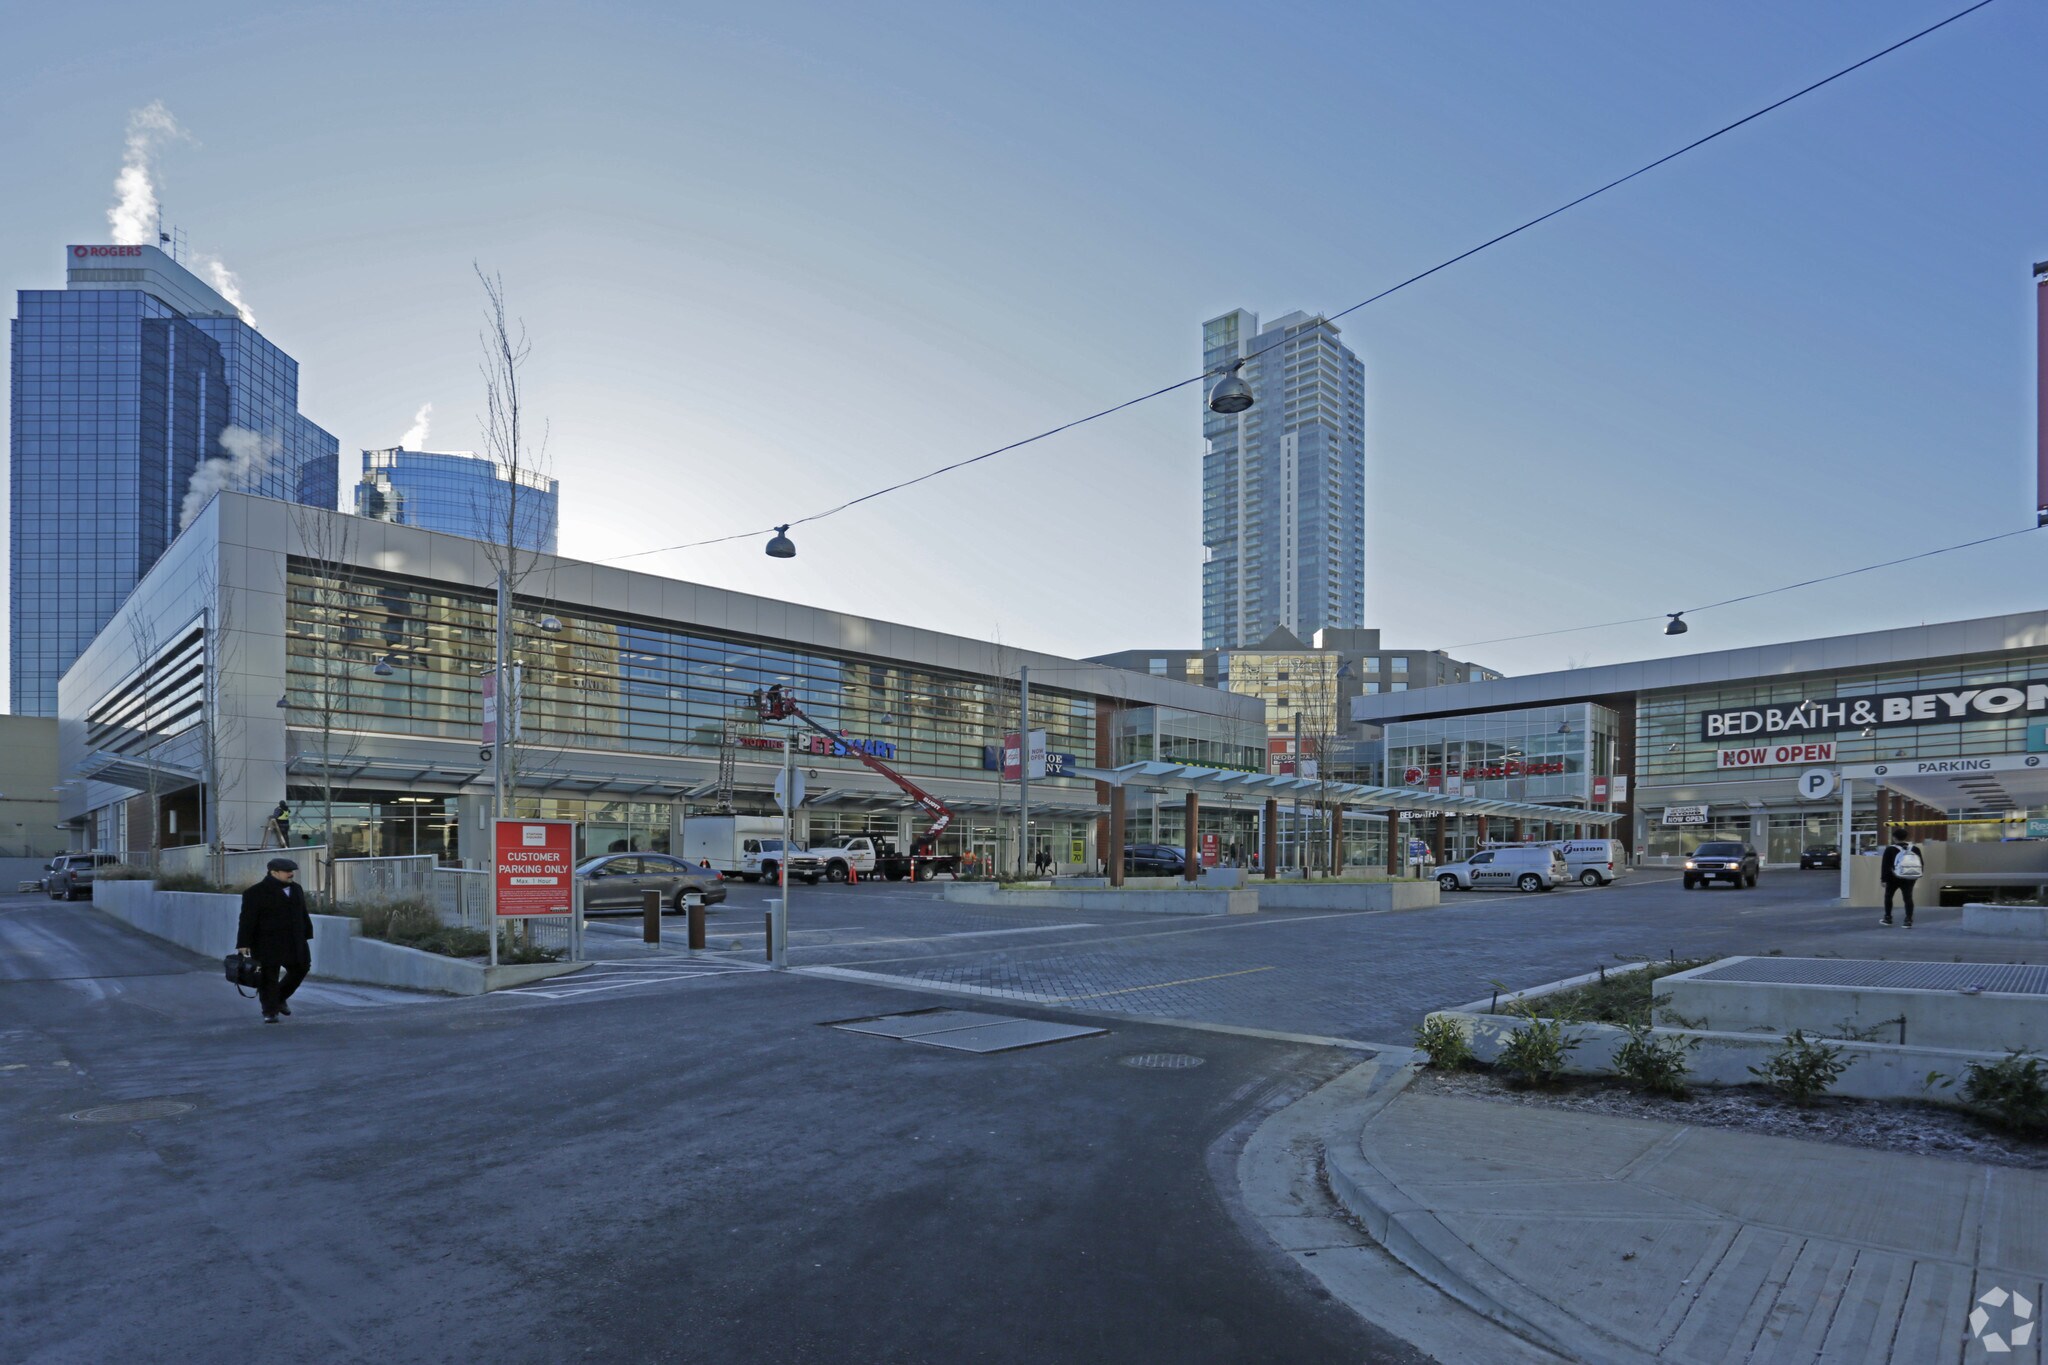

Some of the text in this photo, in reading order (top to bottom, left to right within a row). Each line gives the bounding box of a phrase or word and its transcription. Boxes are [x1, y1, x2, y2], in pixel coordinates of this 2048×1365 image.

[90, 246, 142, 257] ROGERS
[1707, 711, 1763, 737] BED
[1766, 702, 1846, 732] BATH
[1850, 700, 1878, 725] &
[1722, 744, 1832, 766] NOW OPEN
[1917, 759, 1991, 773] PARKING
[1809, 774, 1825, 793] P
[2029, 821, 2048, 830] Re
[507, 852, 560, 861] CUSTOMER
[498, 865, 568, 873] PARKING ONLY
